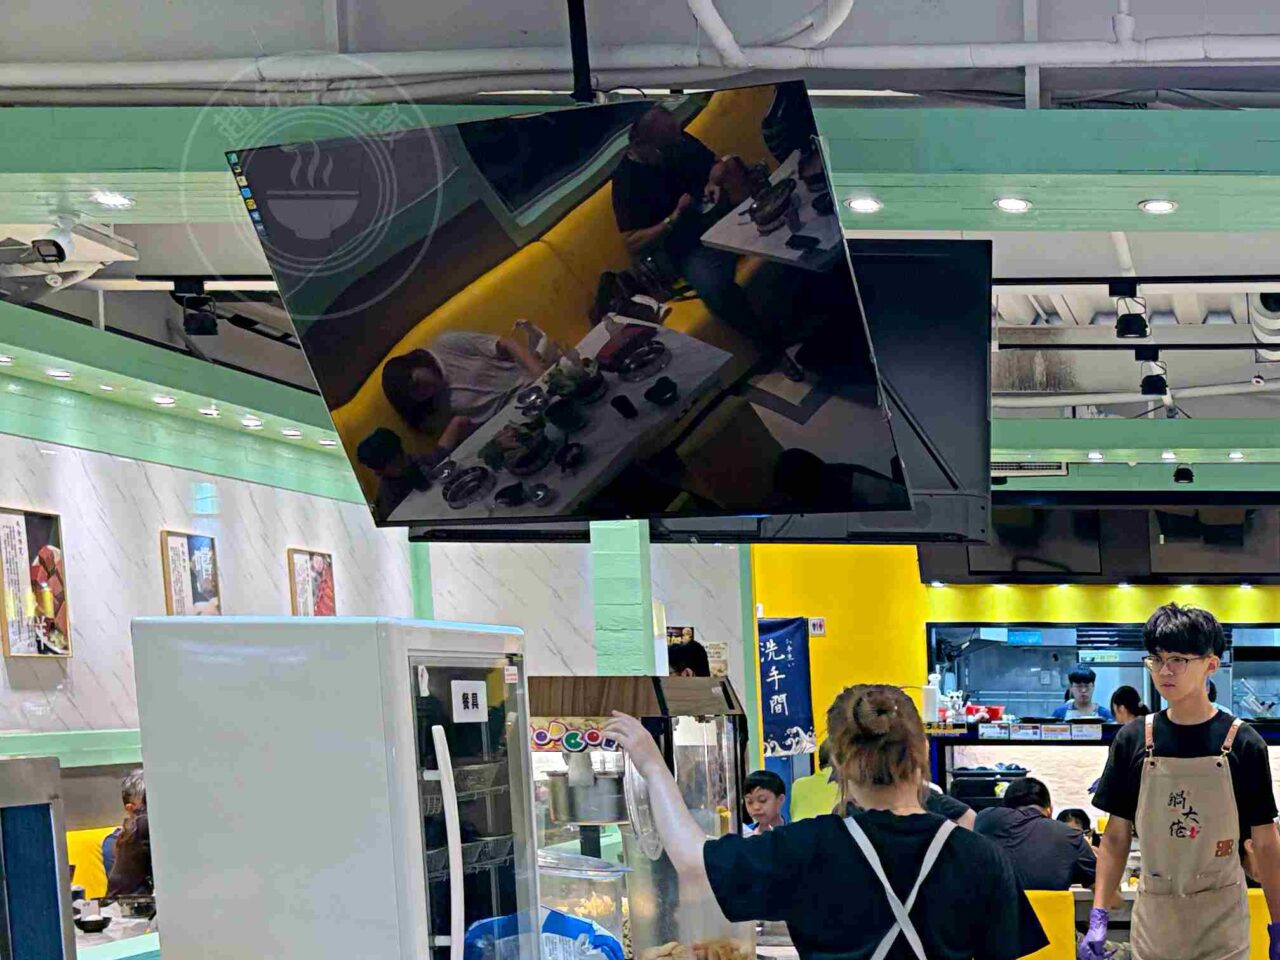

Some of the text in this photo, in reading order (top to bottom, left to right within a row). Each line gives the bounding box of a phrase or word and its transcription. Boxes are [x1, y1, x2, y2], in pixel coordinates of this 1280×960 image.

[462, 692, 480, 710] 餐具
[759, 638, 789, 716] 洗手間
